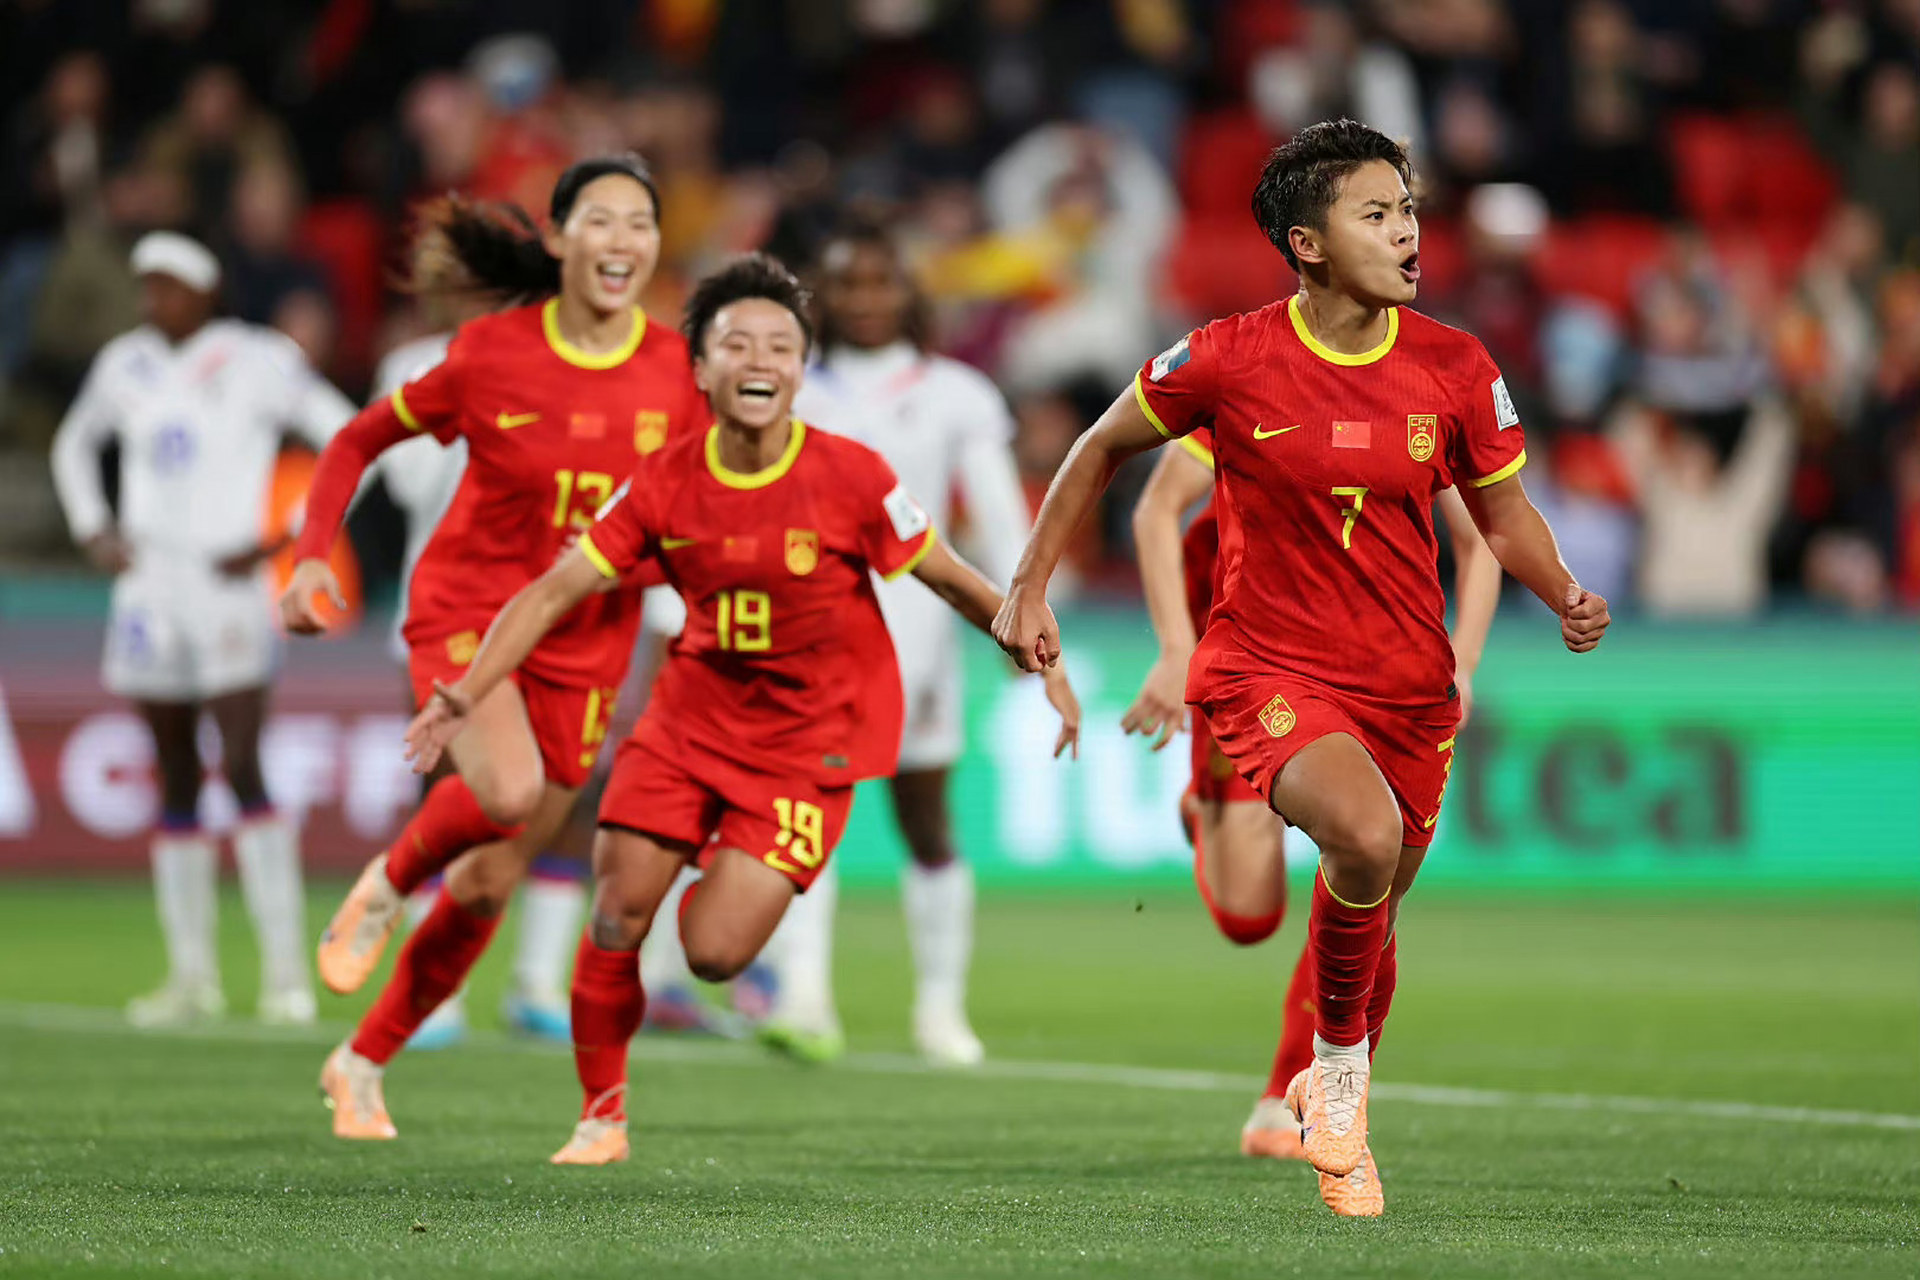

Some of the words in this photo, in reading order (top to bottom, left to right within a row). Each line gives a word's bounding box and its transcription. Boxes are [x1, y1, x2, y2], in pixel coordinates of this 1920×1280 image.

[1410, 417, 1434, 427] CFA
[553, 469, 614, 529] 13
[1331, 487, 1369, 549] 7
[717, 590, 772, 651] 19
[1458, 706, 1748, 858] tea
[773, 798, 823, 868] 19
